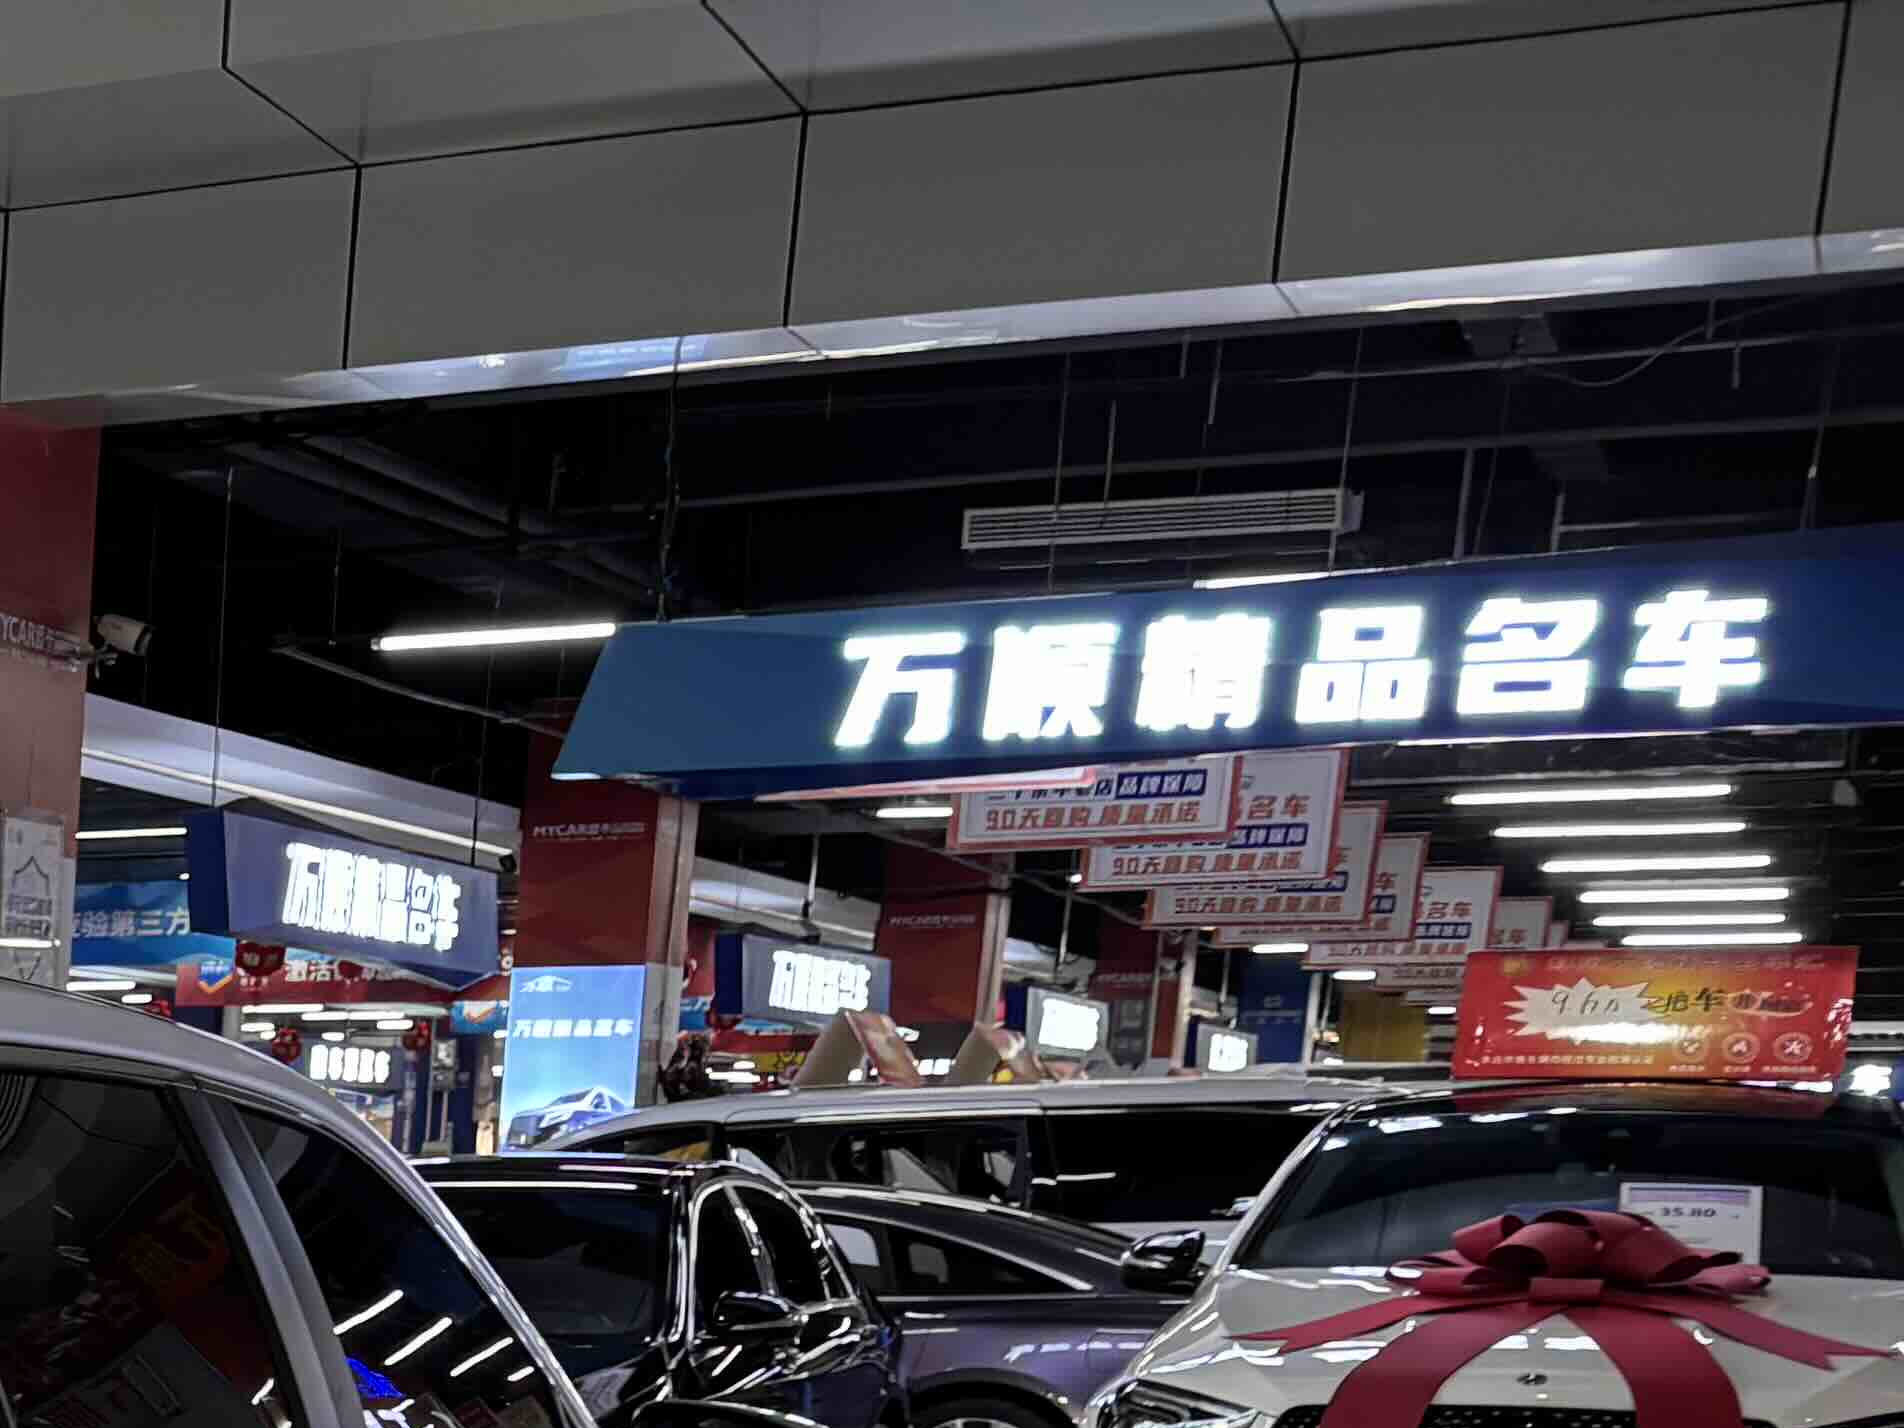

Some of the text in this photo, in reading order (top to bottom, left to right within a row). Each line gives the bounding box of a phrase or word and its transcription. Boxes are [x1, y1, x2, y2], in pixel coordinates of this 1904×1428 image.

[833, 588, 1770, 748] 万顺精品名车
